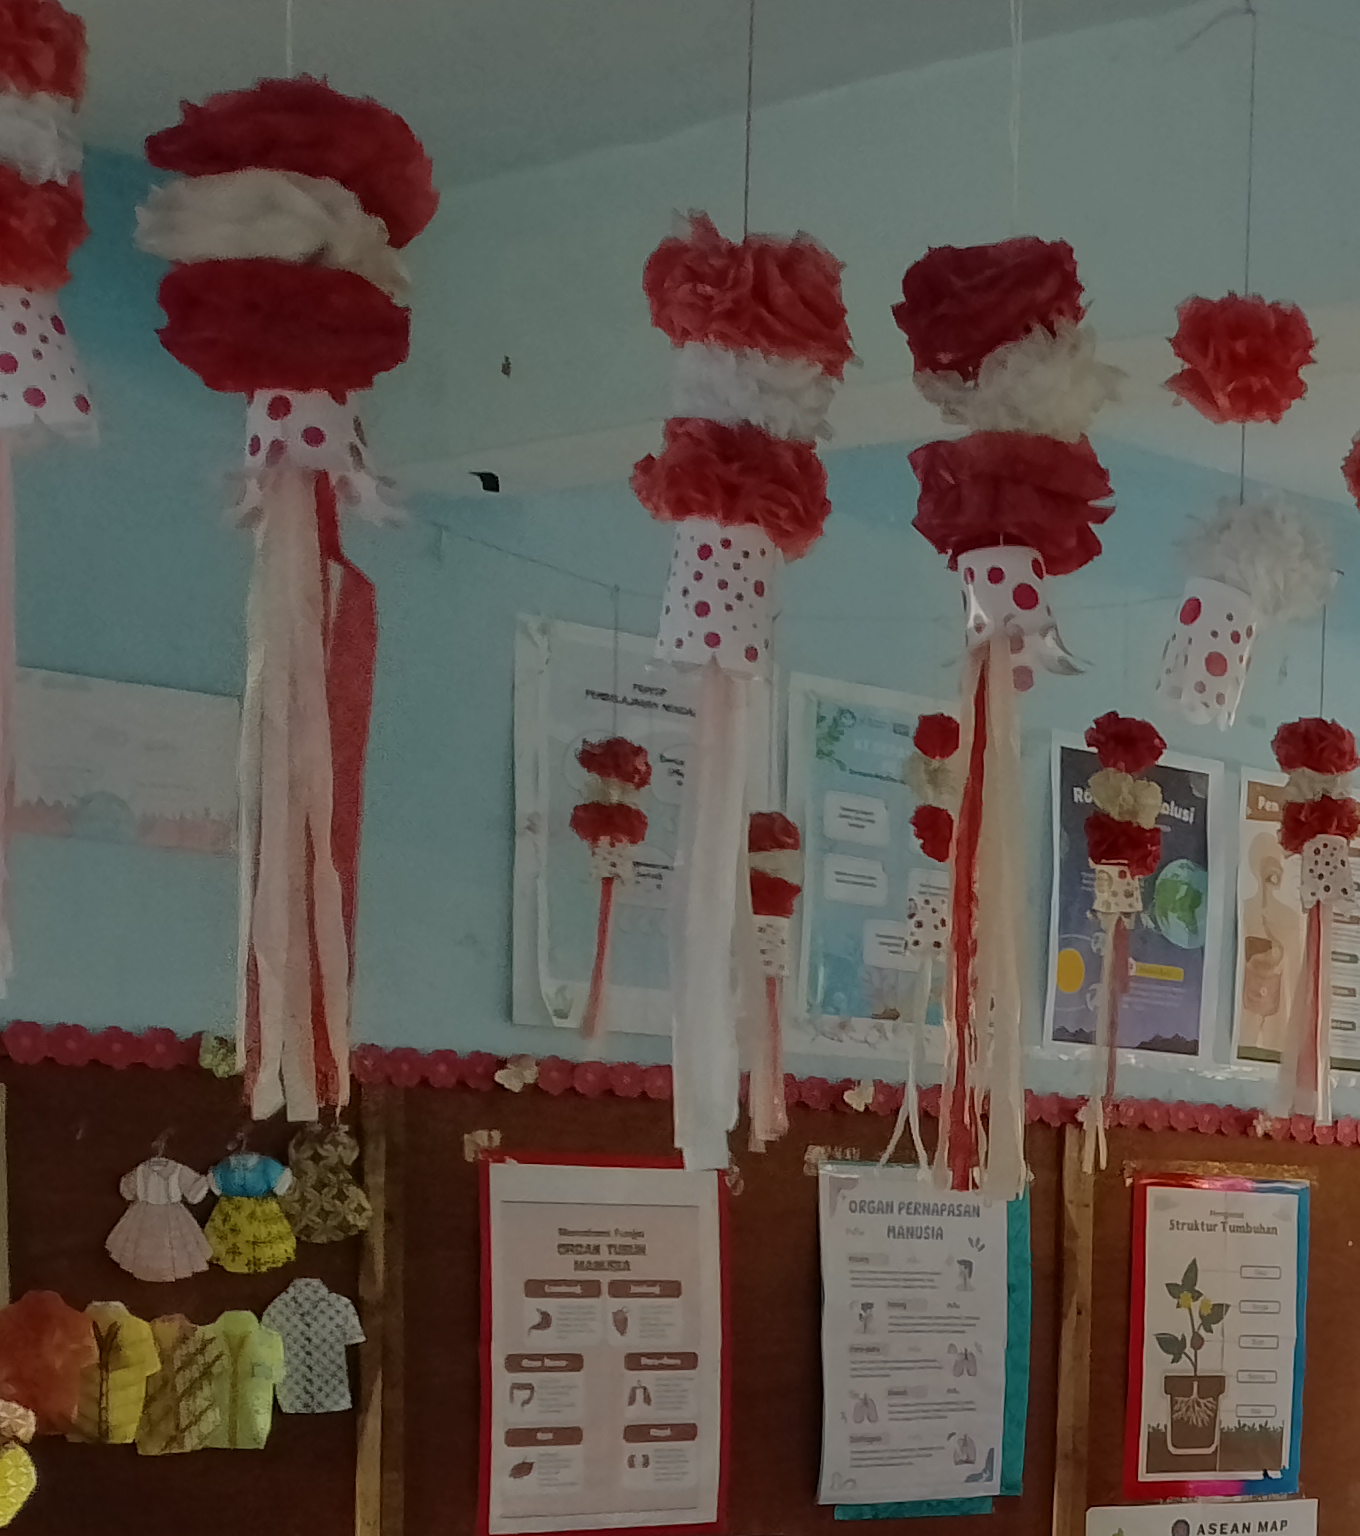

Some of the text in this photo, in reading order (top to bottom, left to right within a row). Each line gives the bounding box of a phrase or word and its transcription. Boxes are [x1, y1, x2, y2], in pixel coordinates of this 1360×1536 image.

[848, 1199, 981, 1218] ORGAN PERNAPASAN
[886, 1224, 944, 1241] MANUSIA
[1168, 1218, 1219, 1232] Struktur
[1196, 1519, 1288, 1536] ASEAN MAP
